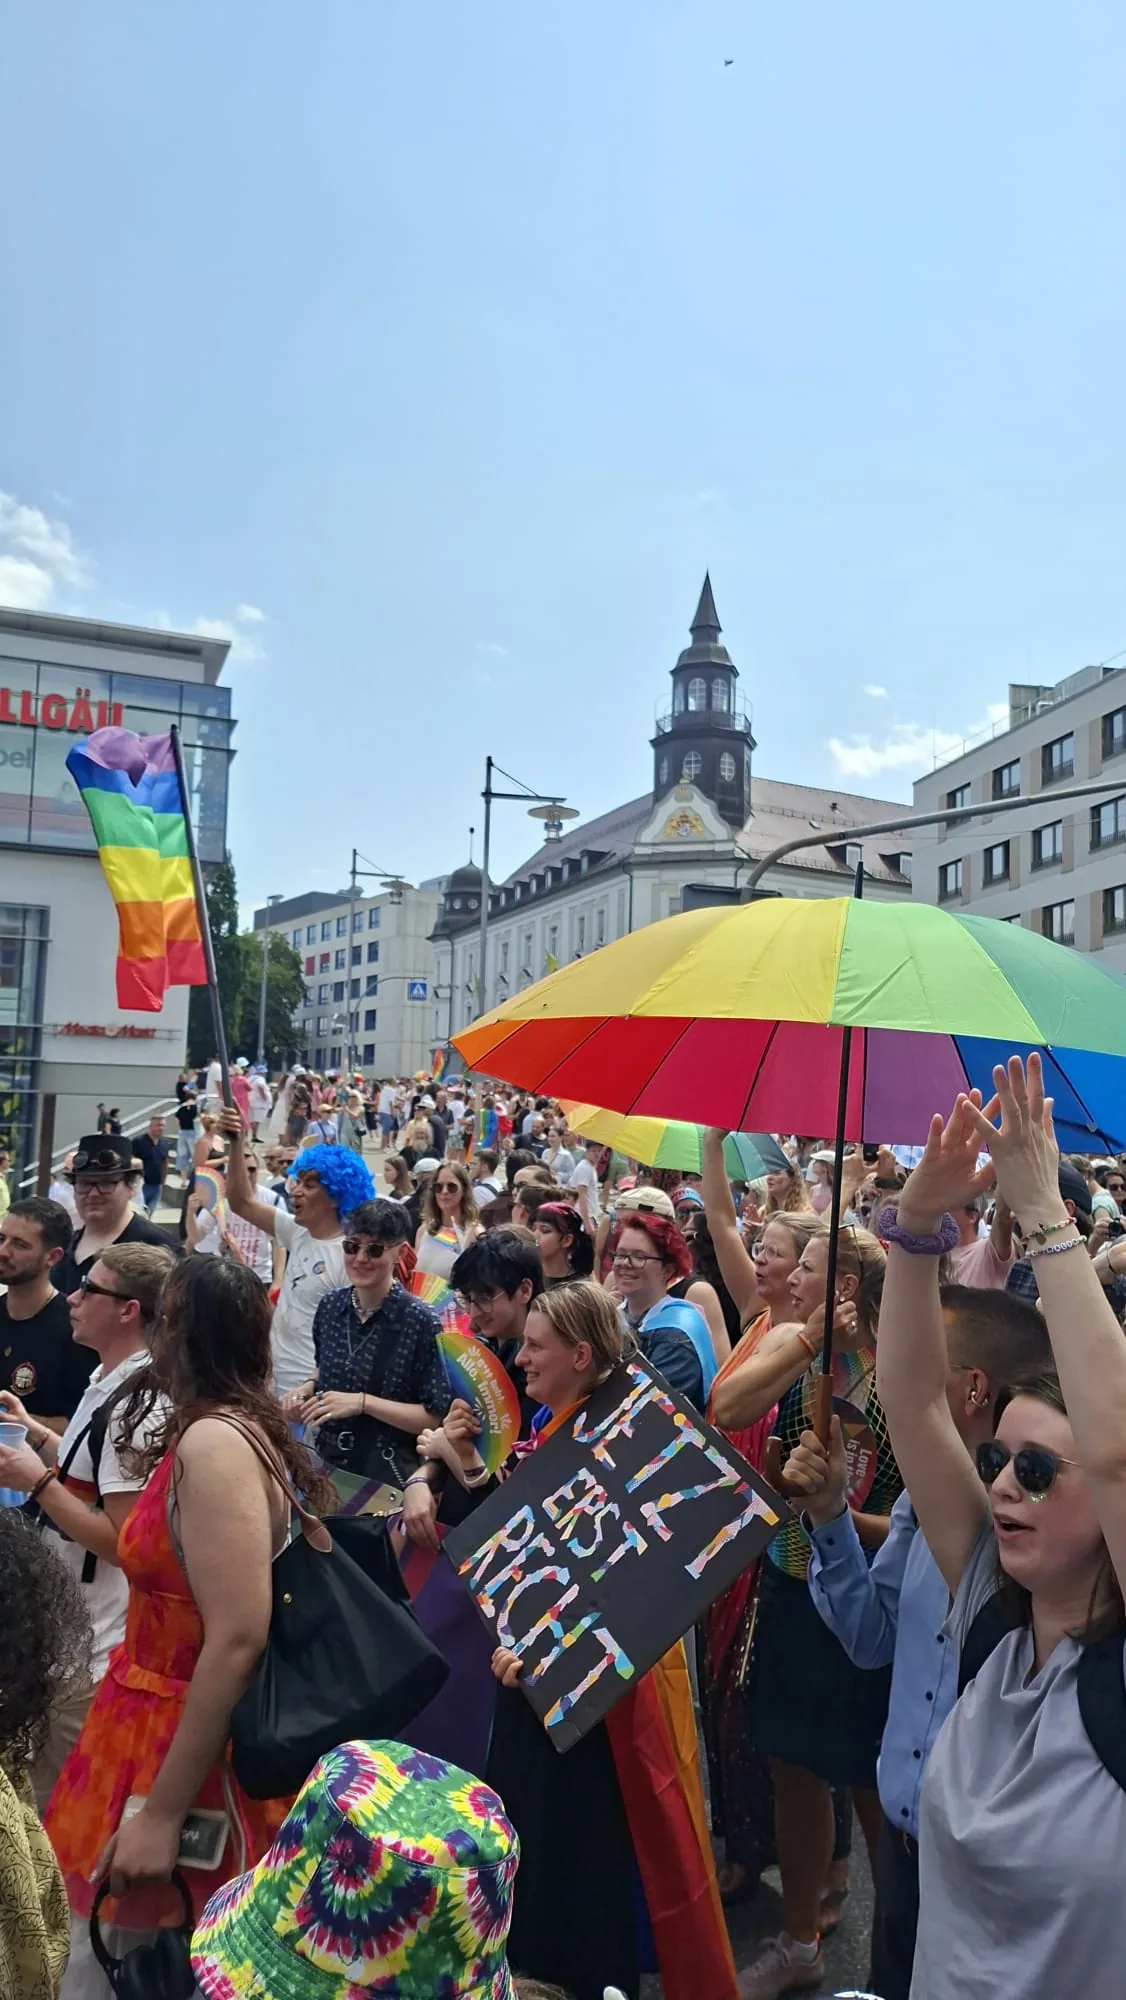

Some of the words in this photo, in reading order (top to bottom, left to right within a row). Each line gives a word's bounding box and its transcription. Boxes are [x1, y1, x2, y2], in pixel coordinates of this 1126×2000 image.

[573, 1363, 780, 1579] JETZT
[846, 1439, 860, 1451] is
[855, 1448, 872, 1477] Love
[542, 1467, 648, 1583] ERST
[458, 1505, 635, 1730] RECHT
